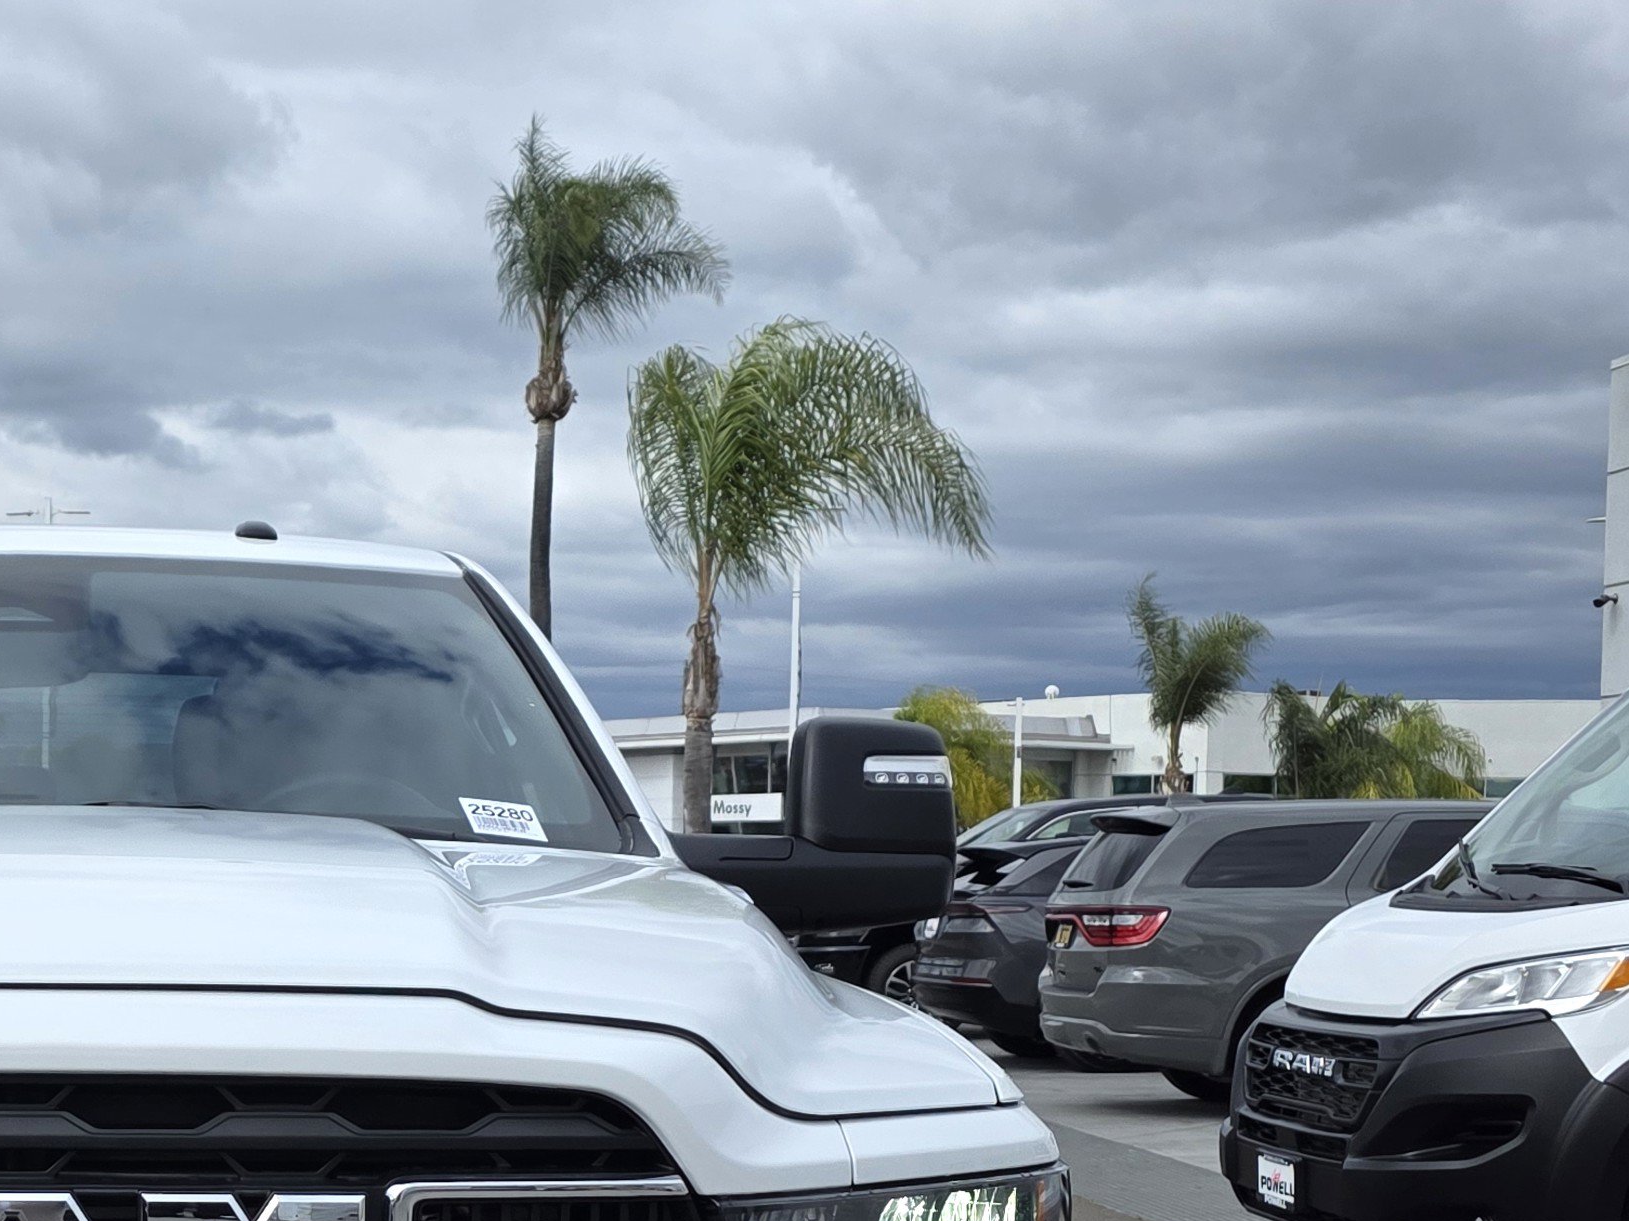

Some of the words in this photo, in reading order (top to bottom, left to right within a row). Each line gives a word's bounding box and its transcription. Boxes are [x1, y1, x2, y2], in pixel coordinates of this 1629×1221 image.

[468, 803, 534, 822] 25280
[713, 800, 752, 817] Mossy
[1273, 1049, 1336, 1077] RAM
